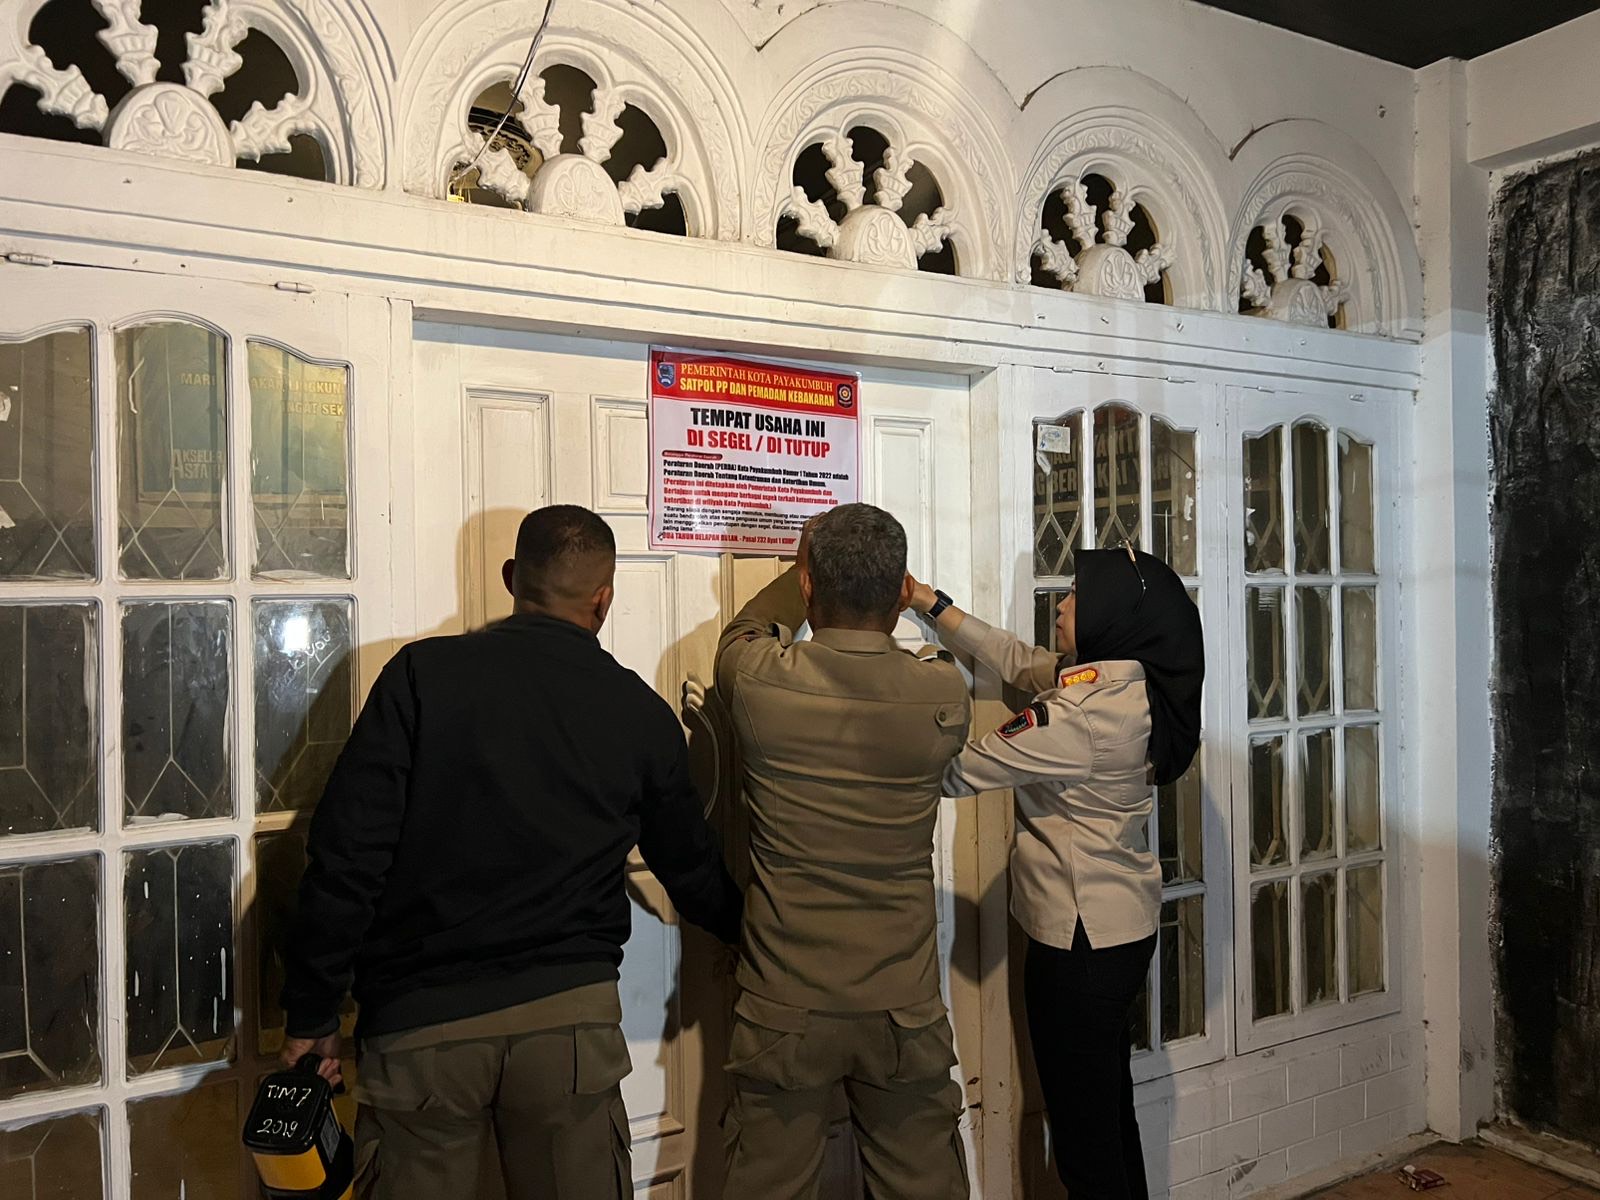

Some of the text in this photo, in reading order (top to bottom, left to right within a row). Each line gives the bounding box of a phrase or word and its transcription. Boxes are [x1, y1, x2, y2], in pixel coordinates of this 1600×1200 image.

[681, 363, 833, 392] PEMERINTAH KOTA PAYAKUMBUH
[680, 378, 715, 392] SATPOL
[716, 380, 728, 394] PP
[729, 382, 746, 396] DAN
[748, 384, 787, 402] PEMADAM
[788, 390, 834, 406] KEBAKARAN
[690, 408, 825, 437] TEMPAT USAHA INI
[687, 429, 831, 458] DI SEGEL / DI TUTUP
[664, 460, 693, 468] Peraturan
[694, 461, 714, 470] Daerah
[715, 463, 737, 471] (PERDA)
[737, 464, 749, 472] Kota
[750, 466, 782, 475] Payakumbuh
[783, 469, 799, 477] Nomor
[664, 469, 693, 477] Peraturan
[694, 470, 714, 478] Daerah
[715, 472, 737, 481] Tentang
[738, 474, 770, 483] Ketentraman
[771, 476, 781, 484] dan
[782, 478, 808, 486] Ketertiban
[664, 487, 693, 495] Bertujuan
[711, 490, 739, 498] mengatur
[739, 492, 762, 500] berbagai
[796, 495, 828, 504] ketentraman
[705, 480, 735, 489] ditetapkan
[748, 484, 776, 492] Pemerintah
[790, 487, 822, 495] Payakumbuh
[664, 497, 694, 505] ketertiban
[722, 508, 741, 516] sengaja
[675, 532, 694, 540] TAHUN
[695, 533, 720, 541] DELAPAN
[742, 535, 756, 543] Pasal
[268, 1085, 312, 1107] TIM 7
[257, 1118, 298, 1138] 2019
